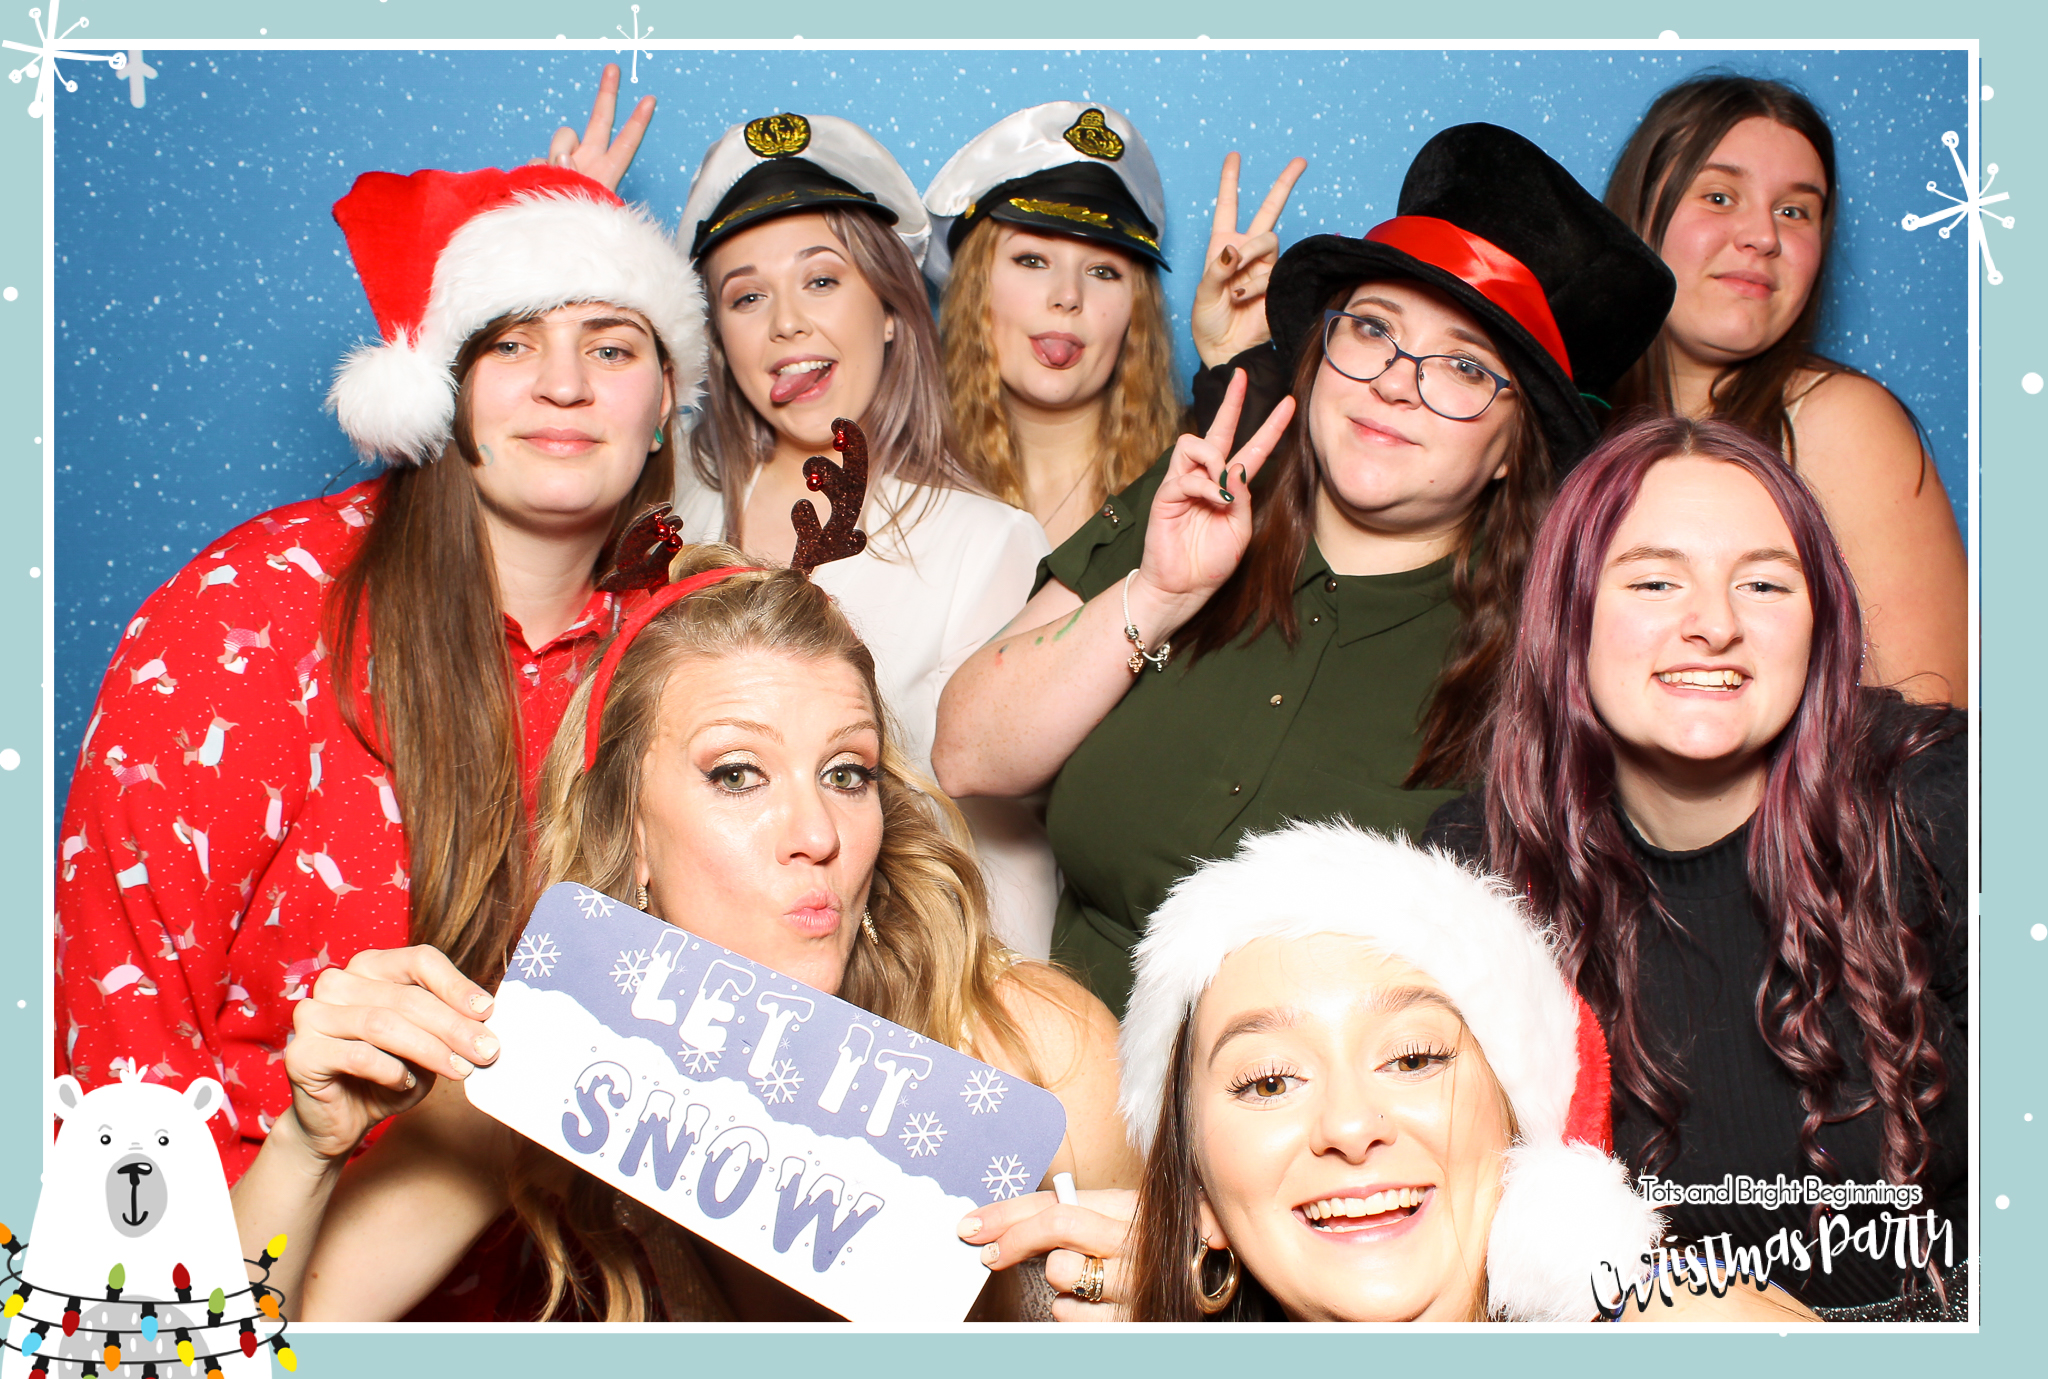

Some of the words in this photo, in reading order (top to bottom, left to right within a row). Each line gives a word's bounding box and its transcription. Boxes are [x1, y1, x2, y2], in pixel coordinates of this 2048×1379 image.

[631, 928, 815, 1079] LET
[817, 1023, 933, 1138] IT
[561, 1060, 885, 1273] SNOW
